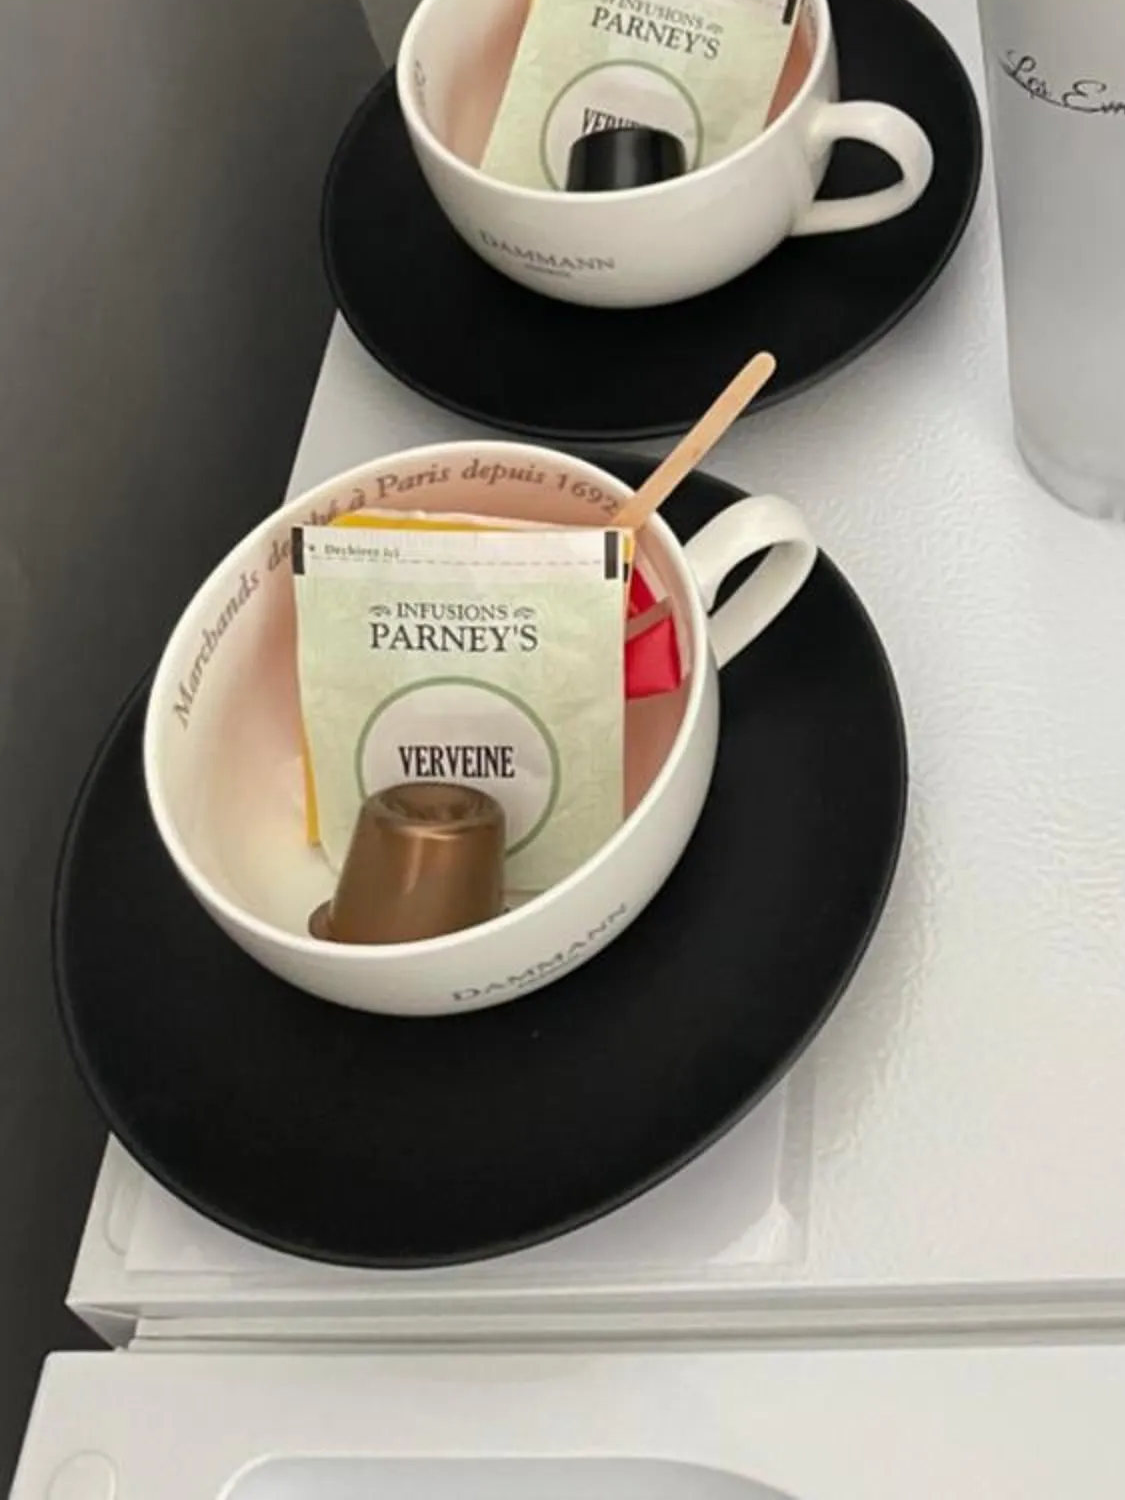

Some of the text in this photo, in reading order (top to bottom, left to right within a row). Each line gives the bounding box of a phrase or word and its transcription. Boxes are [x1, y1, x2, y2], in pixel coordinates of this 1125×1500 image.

[591, 7, 722, 59] PARNEY'S
[478, 228, 617, 271] DAMMANN
[172, 569, 261, 731] Marchands
[376, 461, 451, 500] Paris
[461, 458, 546, 485] depuis
[555, 473, 622, 517] 1692
[396, 602, 509, 621] INFUSIONS
[369, 622, 539, 653] PARNEY'S
[398, 745, 516, 779] VERVEINE
[452, 903, 627, 1001] DAMMANN
